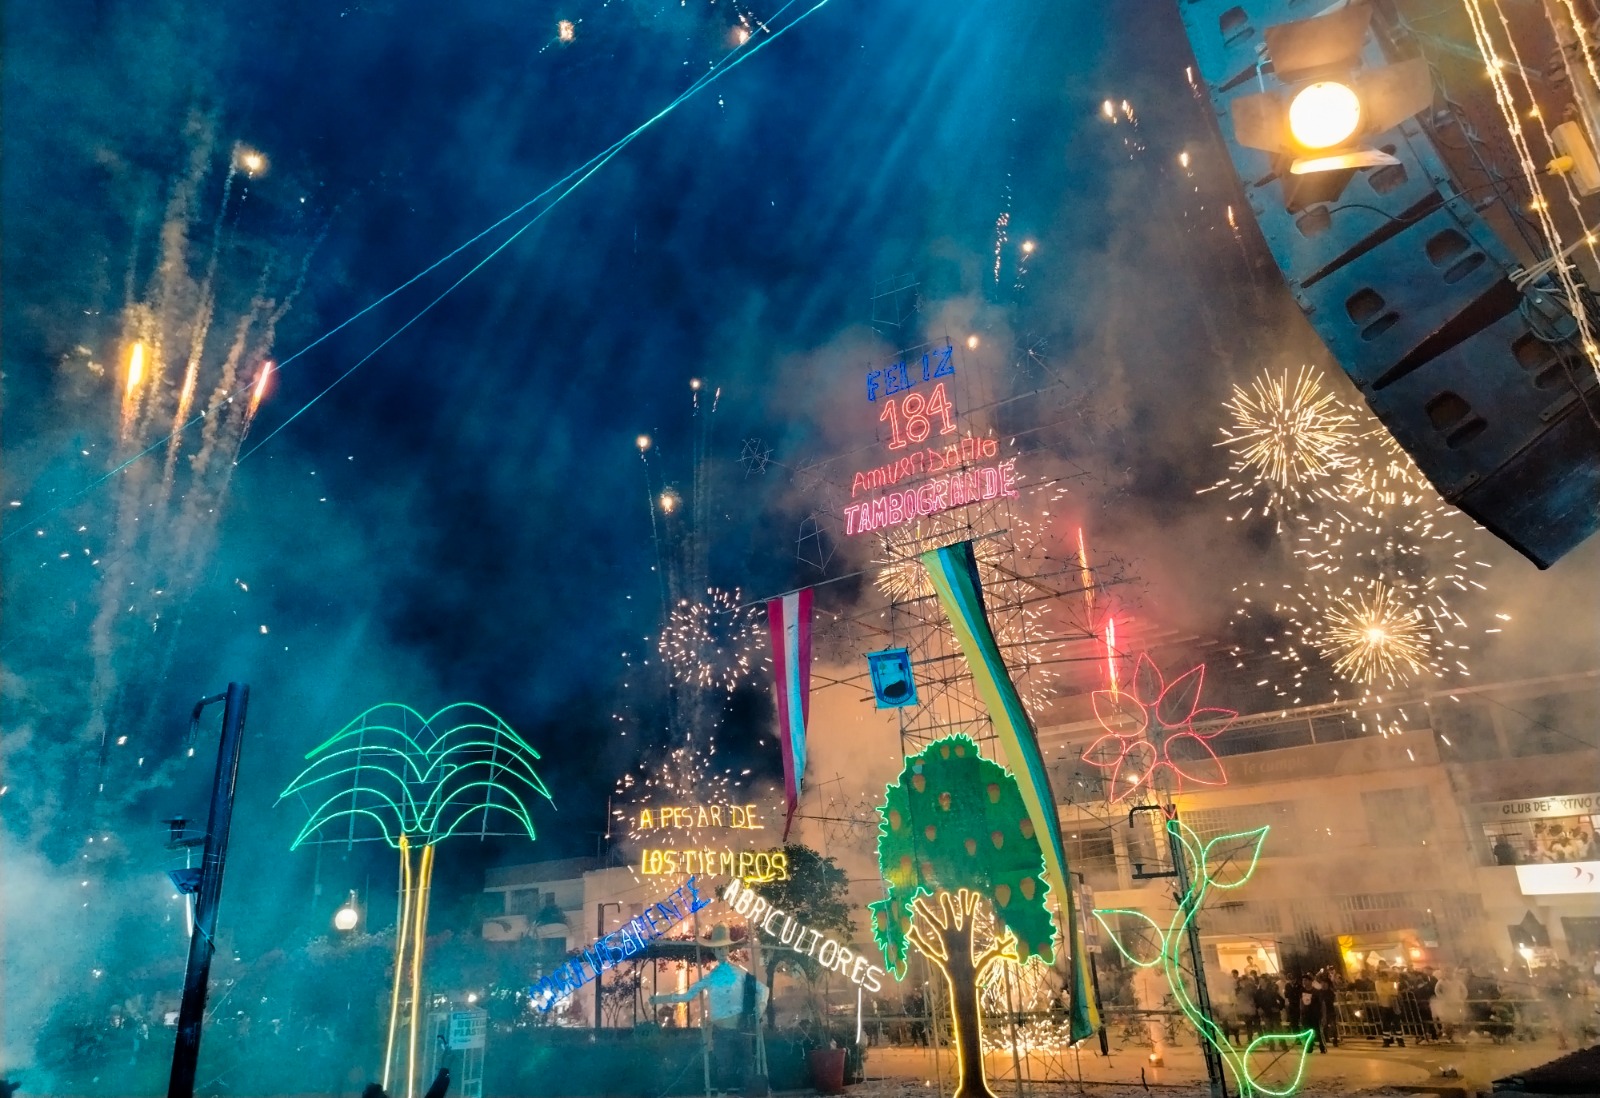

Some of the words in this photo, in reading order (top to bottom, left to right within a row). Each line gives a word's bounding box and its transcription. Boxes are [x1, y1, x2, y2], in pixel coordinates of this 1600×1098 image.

[866, 346, 955, 402] FELIZ
[880, 382, 956, 450] 184
[844, 463, 1018, 534] TAMBOGRANDE
[640, 808, 653, 828] A
[660, 805, 722, 829] PESAR
[730, 804, 765, 829] DE
[1503, 803, 1531, 815] CLUB
[1534, 797, 1592, 812] DEPRTIVO
[641, 849, 678, 876] LOS
[682, 850, 788, 881] TIEMPOS
